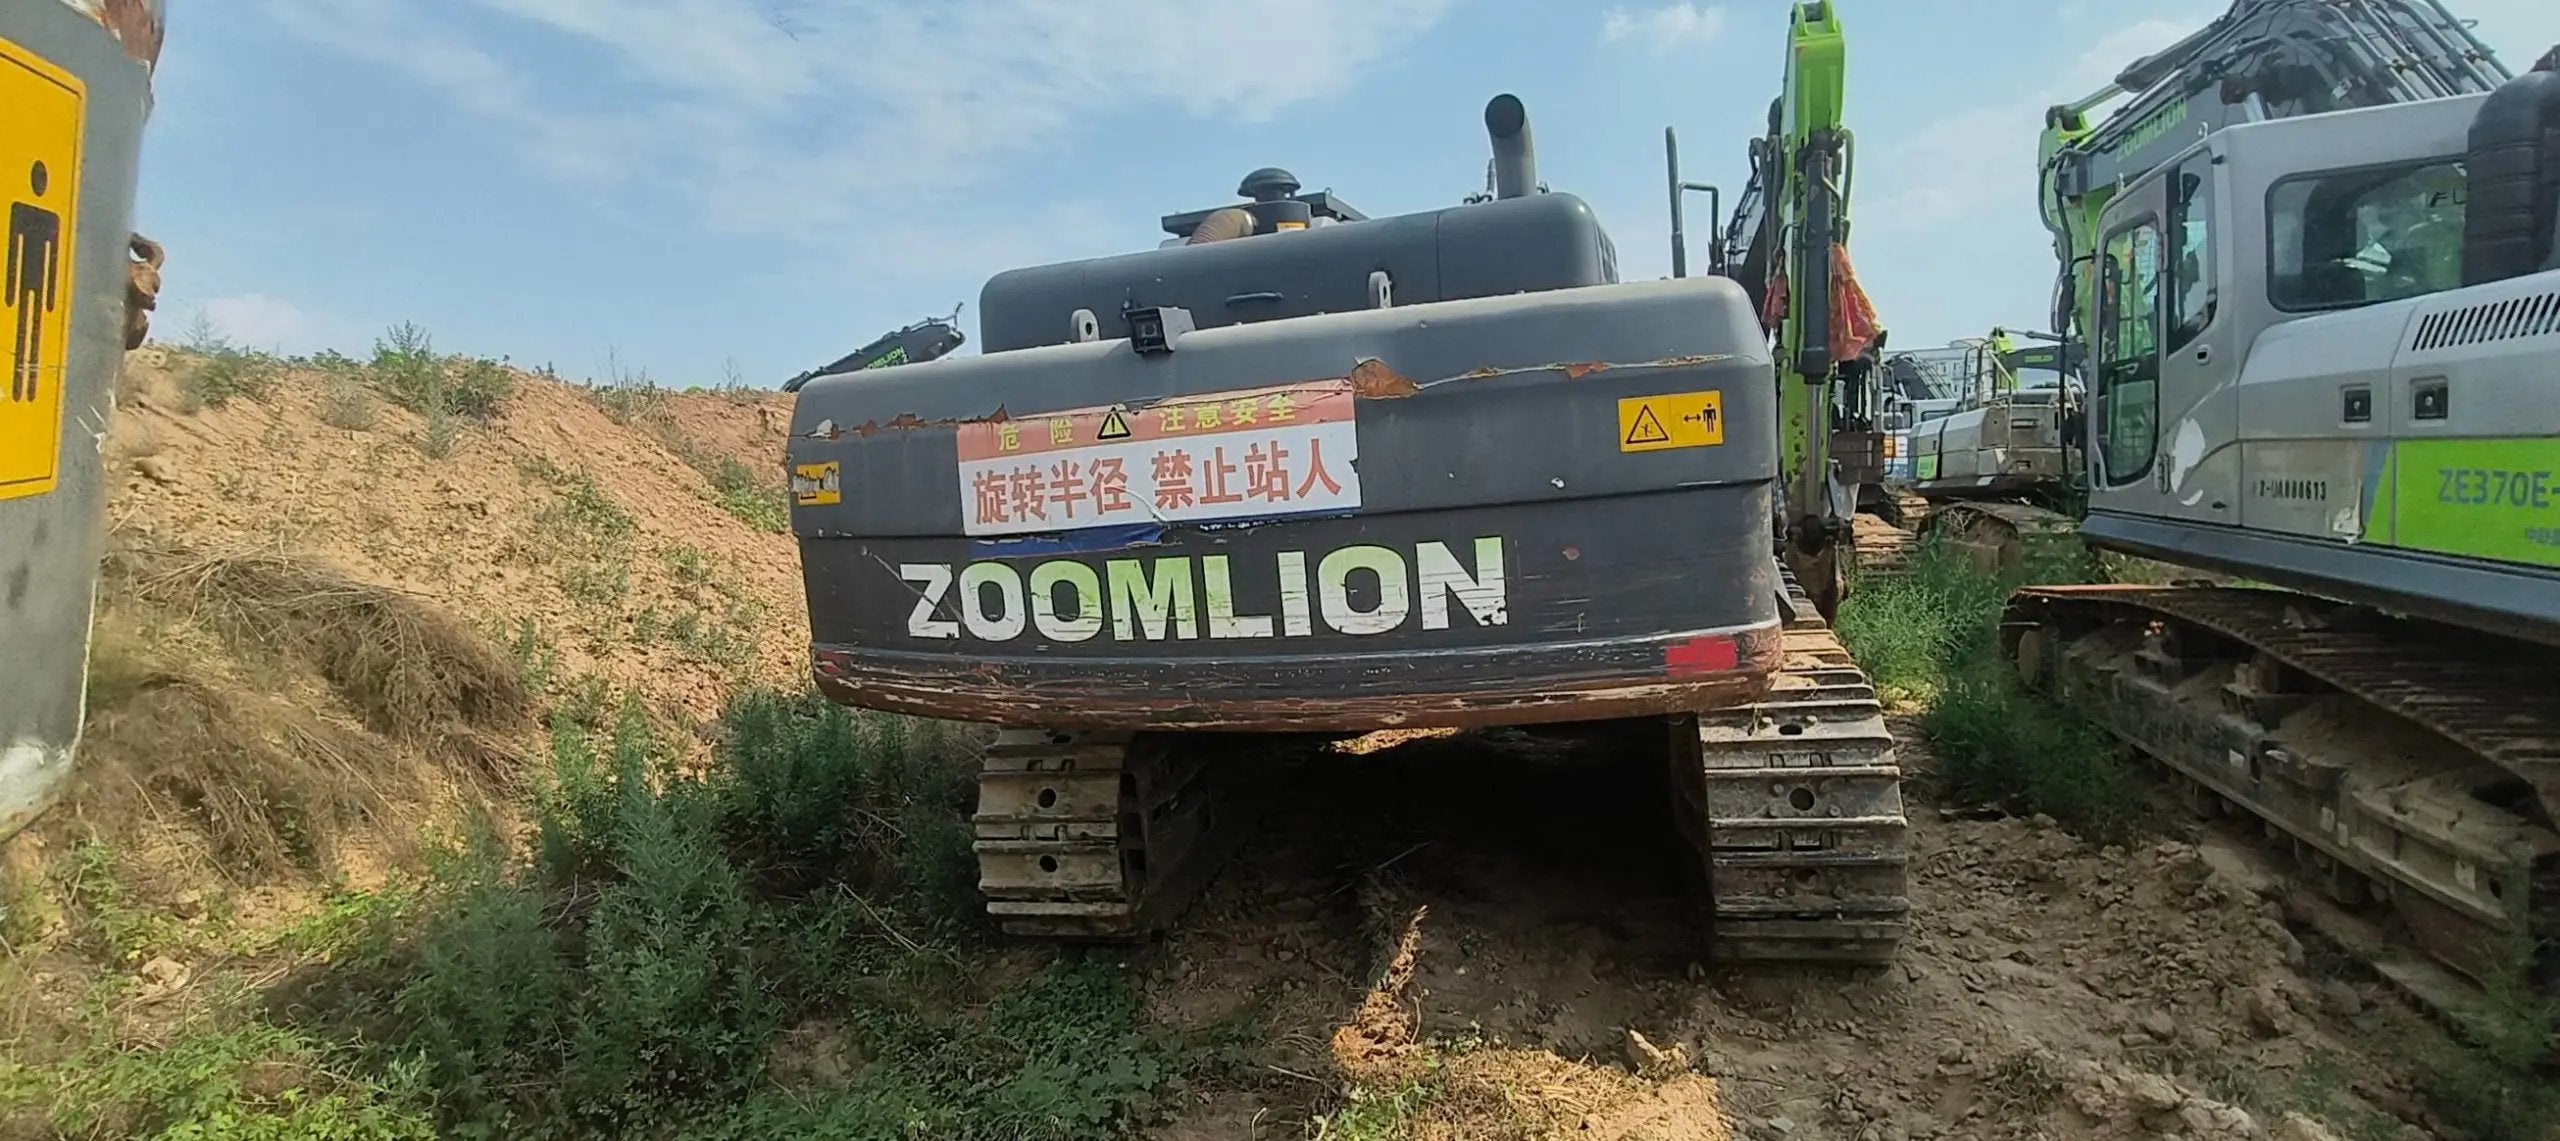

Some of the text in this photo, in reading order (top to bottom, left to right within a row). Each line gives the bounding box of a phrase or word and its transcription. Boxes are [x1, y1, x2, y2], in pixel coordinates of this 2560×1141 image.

[1158, 394, 1297, 433] 注意安全
[972, 438, 1342, 526] 旋转半径 禁止站人
[900, 536, 1508, 642] ZOOMLION
